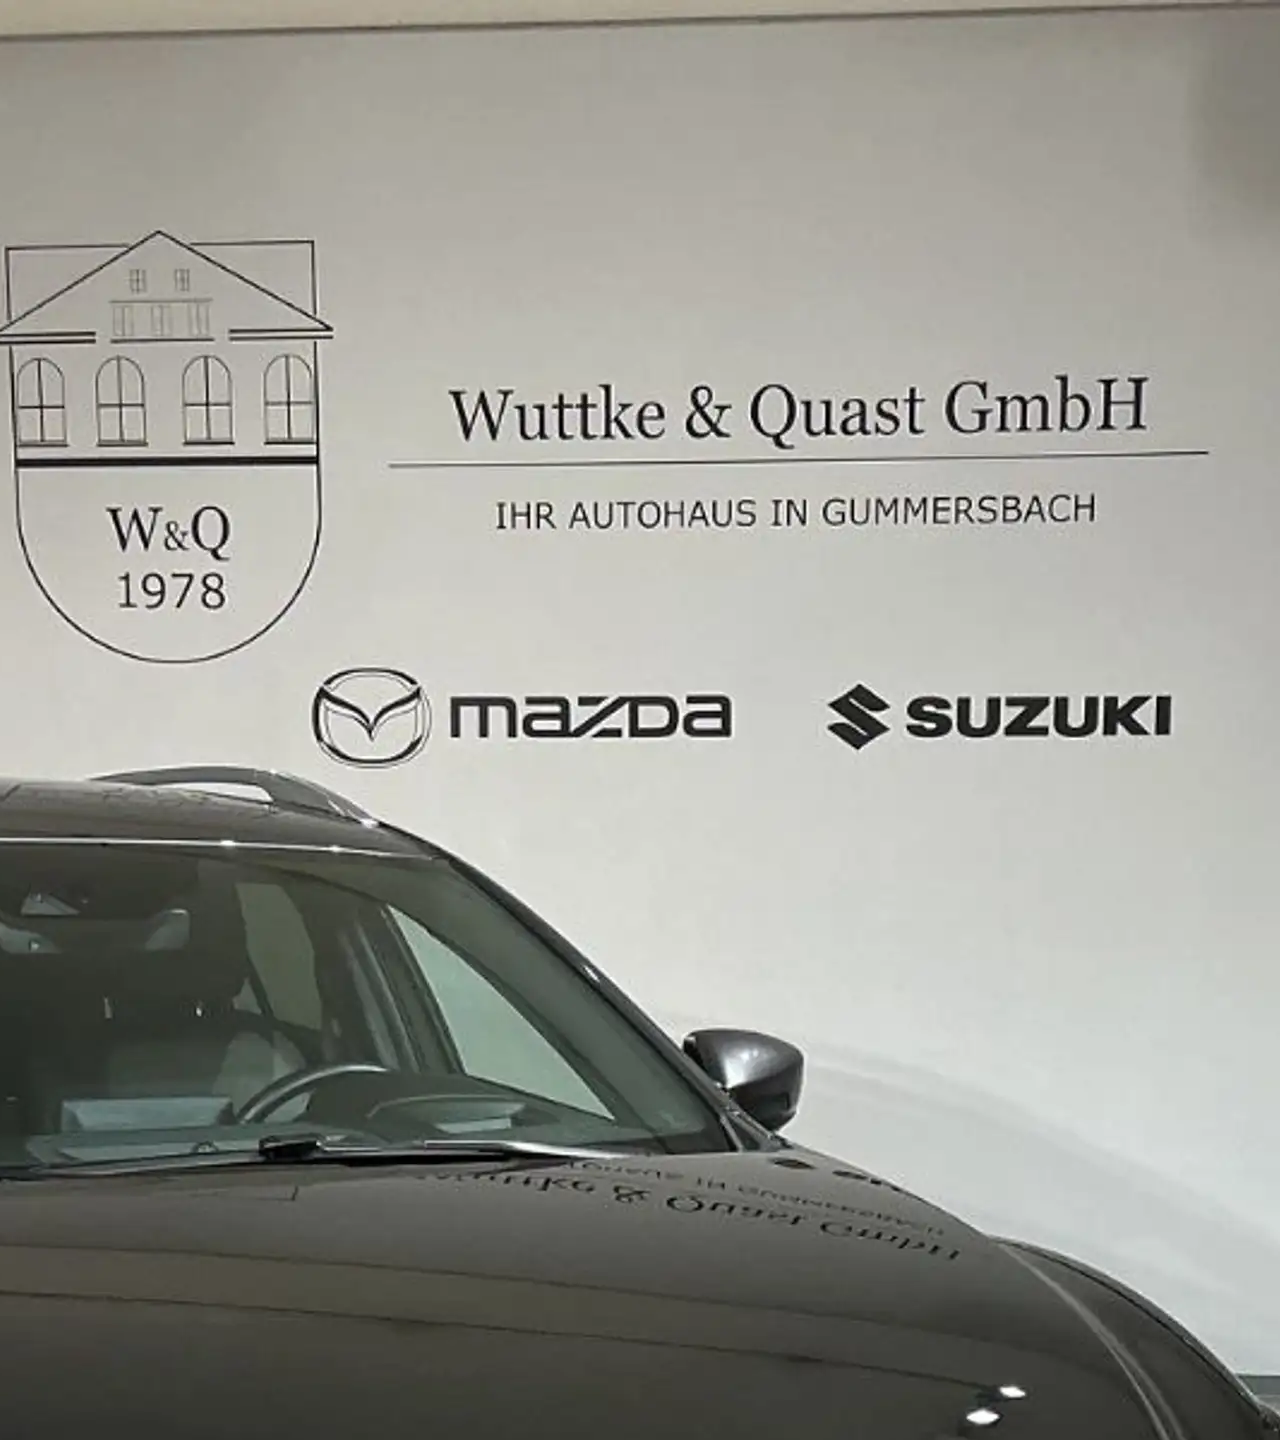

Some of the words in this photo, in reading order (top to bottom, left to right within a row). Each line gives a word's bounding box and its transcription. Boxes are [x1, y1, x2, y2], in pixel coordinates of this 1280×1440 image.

[449, 384, 666, 442] Wuttke
[685, 384, 733, 440] &
[750, 383, 926, 450] Quast
[943, 374, 1149, 435] GmbH
[105, 505, 231, 561] W&Q
[495, 500, 557, 530] IHR
[568, 499, 757, 530] AUTOHAUS
[772, 498, 808, 527] IN
[822, 493, 1096, 527] GUMMERSBACH
[118, 571, 226, 610] 1978
[906, 695, 1172, 738] SUZUKI
